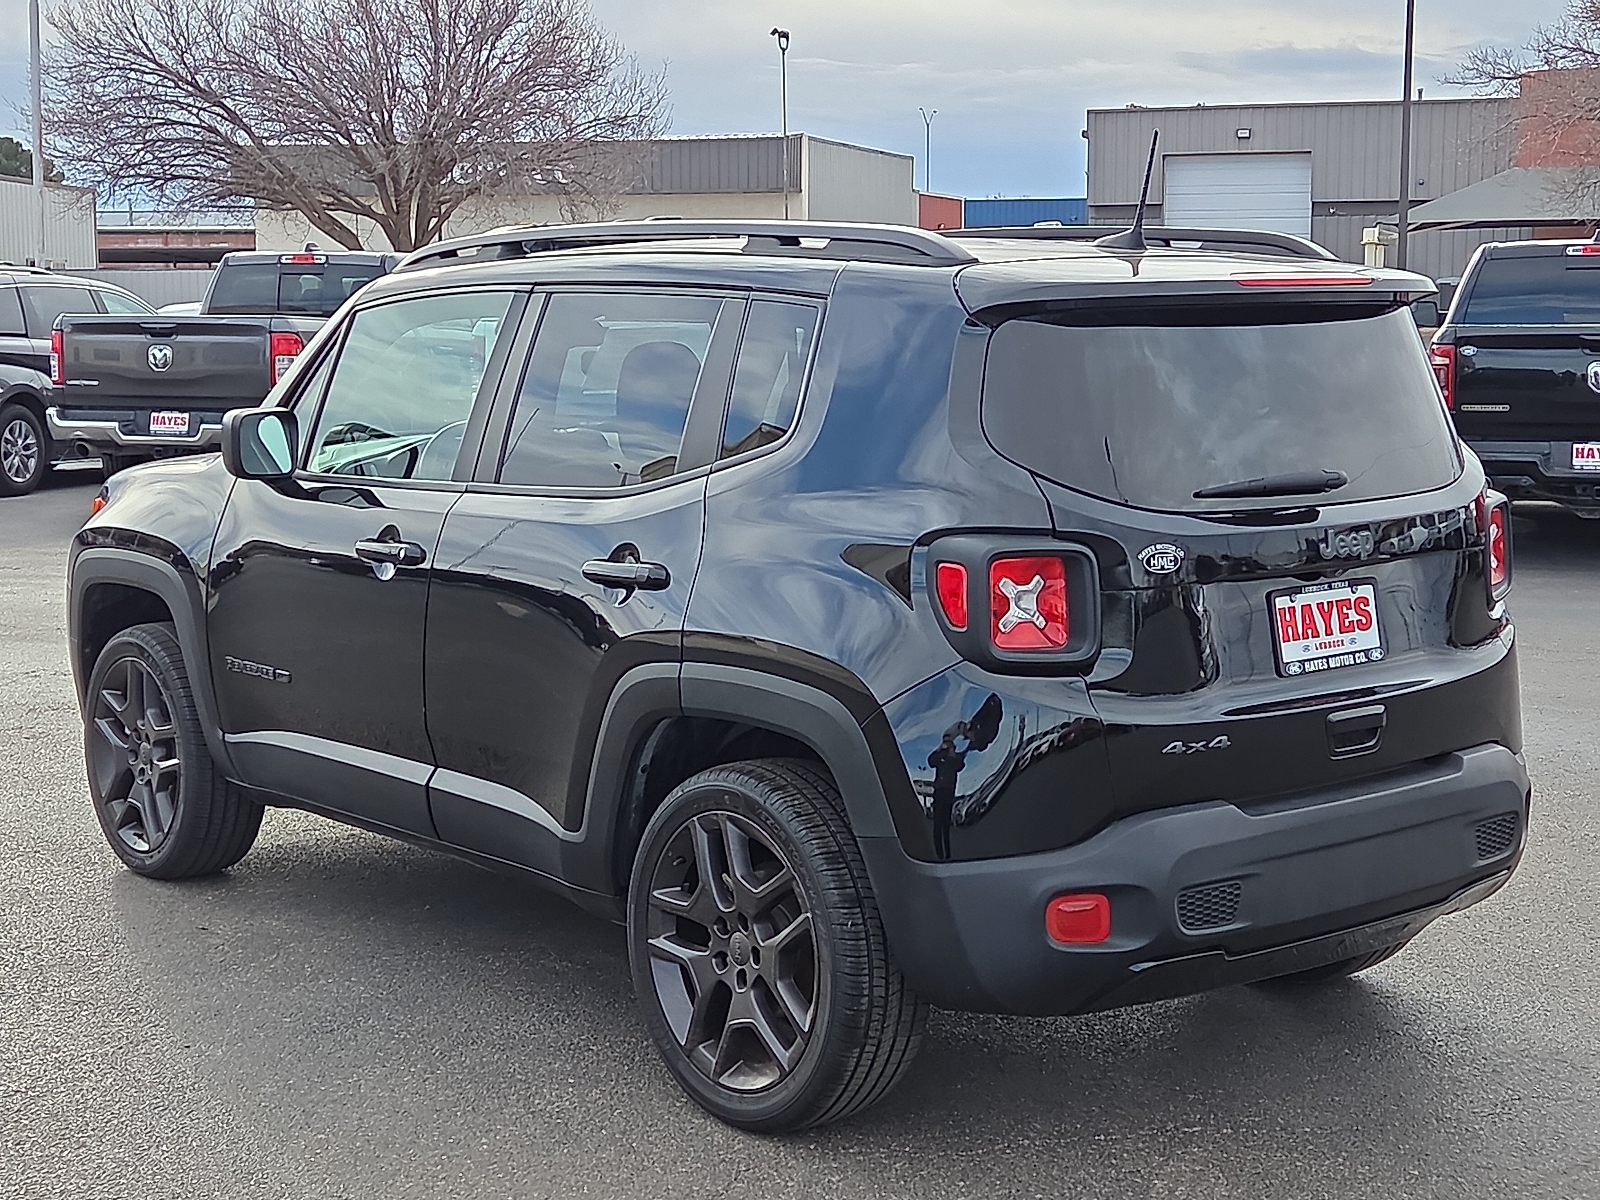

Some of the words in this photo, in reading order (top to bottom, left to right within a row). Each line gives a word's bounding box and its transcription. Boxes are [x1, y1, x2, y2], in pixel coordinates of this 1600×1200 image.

[152, 415, 187, 426] HAYES
[1319, 528, 1374, 560] Jeep
[1150, 553, 1175, 570] HMC
[1277, 596, 1373, 643] HAYES
[1304, 659, 1328, 673] HAYES
[1328, 653, 1355, 668] MOTOR
[1354, 651, 1369, 664] CO.
